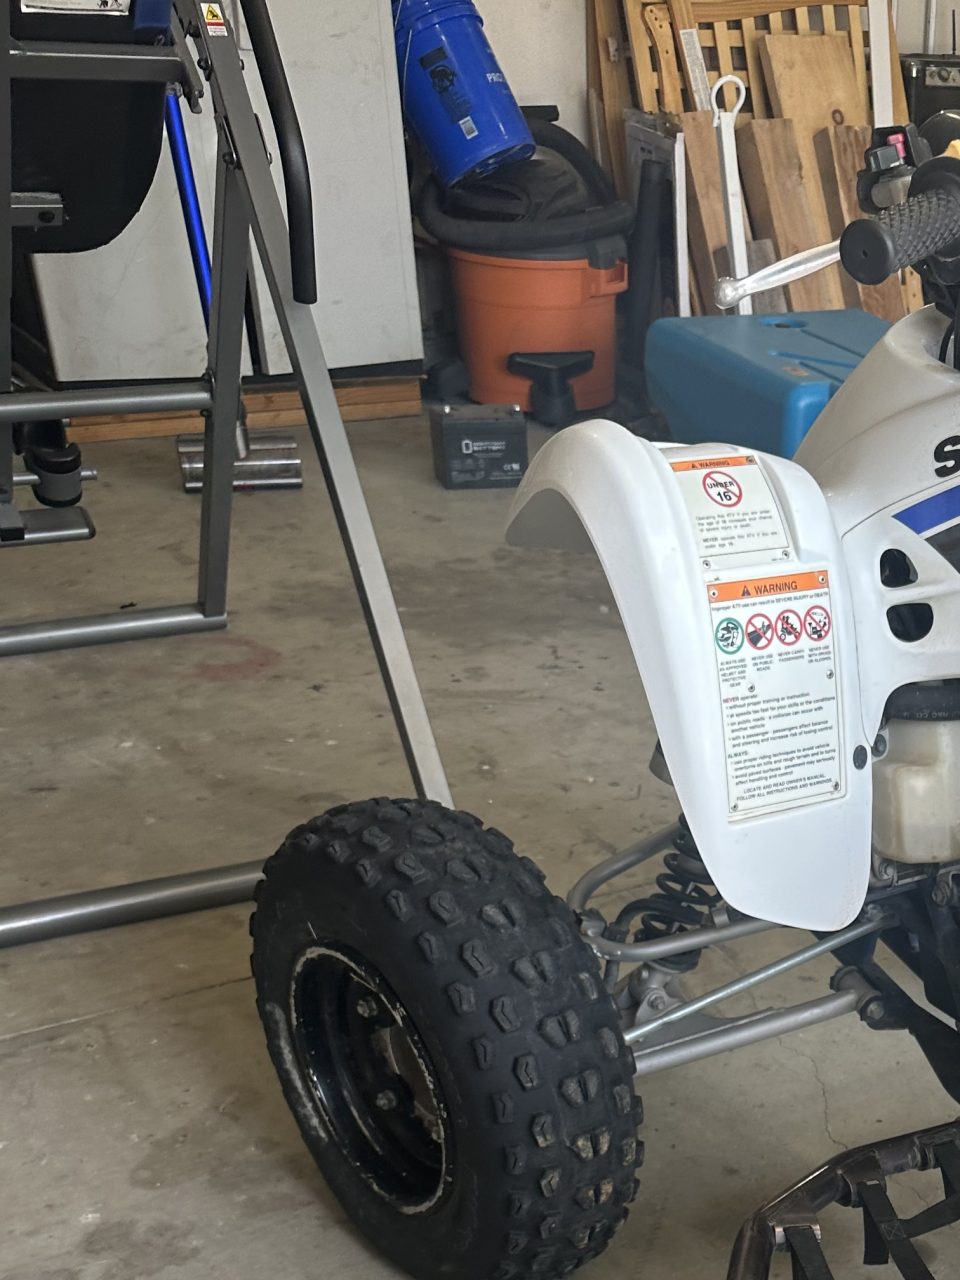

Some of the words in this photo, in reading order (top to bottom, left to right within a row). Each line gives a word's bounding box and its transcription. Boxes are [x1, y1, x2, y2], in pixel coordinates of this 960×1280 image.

[698, 460, 730, 468] WARNING
[707, 481, 735, 489] UNDER
[716, 490, 733, 502] 16
[754, 581, 798, 595] WARNING
